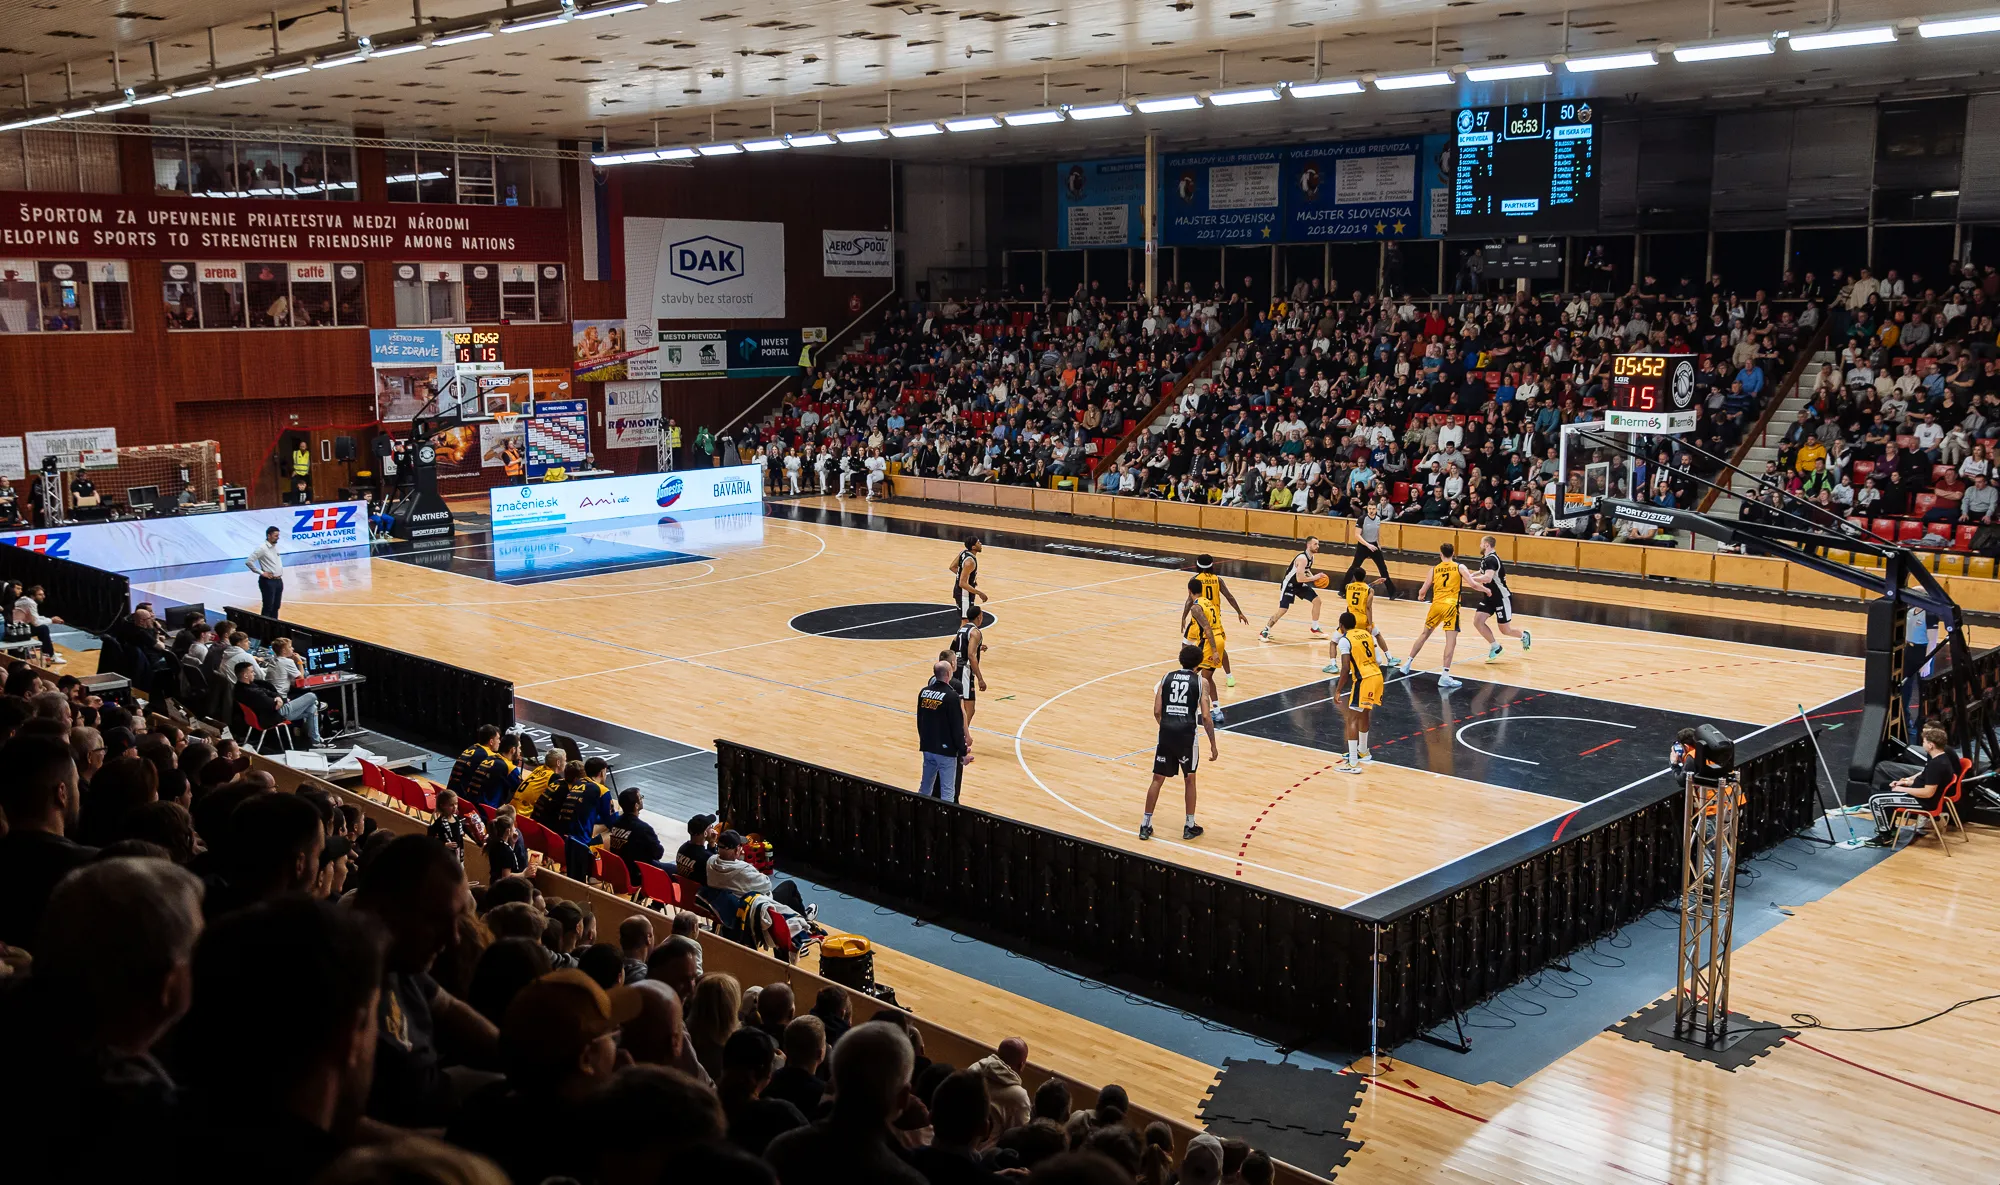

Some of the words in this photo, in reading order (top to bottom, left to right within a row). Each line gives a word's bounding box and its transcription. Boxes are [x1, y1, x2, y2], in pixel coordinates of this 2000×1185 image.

[1477, 111, 1489, 126] 57
[1522, 107, 1528, 118] 3
[1560, 104, 1574, 120] 50
[1510, 118, 1538, 134] 05:53
[1497, 132, 1502, 143] 2
[1545, 129, 1551, 140] 2
[1290, 145, 1344, 158] VOLEJBALOVÝ
[1345, 145, 1366, 154] KLUB
[1368, 143, 1410, 153] PRIEVIDZA
[1169, 154, 1216, 167] VOLEJBALOVÝ
[1217, 155, 1236, 163] KLUB
[1237, 153, 1275, 161] PRIEVIDZA
[20, 203, 103, 223] ŠPORTOM
[117, 210, 137, 224] ZA
[148, 211, 237, 226] UPEVNENIE
[249, 213, 343, 228] PRIATEĽSTVA
[353, 215, 397, 229] MEDZI
[408, 212, 470, 231] NÁRODMI
[1175, 214, 1217, 226] MAJSTER
[1219, 212, 1276, 224] SLOVENSKA
[1296, 209, 1345, 221] MAJSTER
[1347, 207, 1412, 219] SLOVENSKA
[1196, 228, 1252, 239] 2017/2018
[1307, 223, 1368, 236] 2018/2019
[93, 231, 156, 246] SPORTS
[169, 232, 189, 246] TO
[201, 232, 298, 248] STRENGTHEN
[308, 234, 394, 249] FRIENDSHIP
[404, 235, 453, 249] AMONG
[462, 237, 516, 251] NATIONS
[679, 249, 737, 272] DAK
[204, 267, 237, 279] arena
[661, 292, 695, 305] stavby
[697, 292, 715, 304] bez
[388, 331, 413, 343] VŠETKO
[473, 332, 499, 344] 05:52
[633, 329, 653, 337] TIMES
[375, 341, 400, 355] VAŠE
[761, 338, 789, 346] INVEST
[460, 348, 470, 361] 15
[482, 348, 496, 361] 15
[761, 348, 789, 356] PORTAL
[1614, 356, 1665, 377] 05:52
[487, 378, 509, 386] TIPOS
[620, 389, 659, 405] RELAS
[1629, 386, 1654, 409] 15
[1619, 416, 1662, 430] hermés
[713, 481, 752, 498] BAVARIA
[496, 496, 559, 513] značenie.sk
[412, 511, 449, 522] PARTNERS
[292, 531, 325, 540] PODLAHY
[333, 528, 356, 536] DVERE
[1441, 573, 1449, 588] 7
[1206, 585, 1213, 600] 0
[1351, 592, 1360, 605] 5
[1210, 608, 1217, 624] 3
[1362, 640, 1373, 658] 8
[1169, 680, 1190, 704] 32
